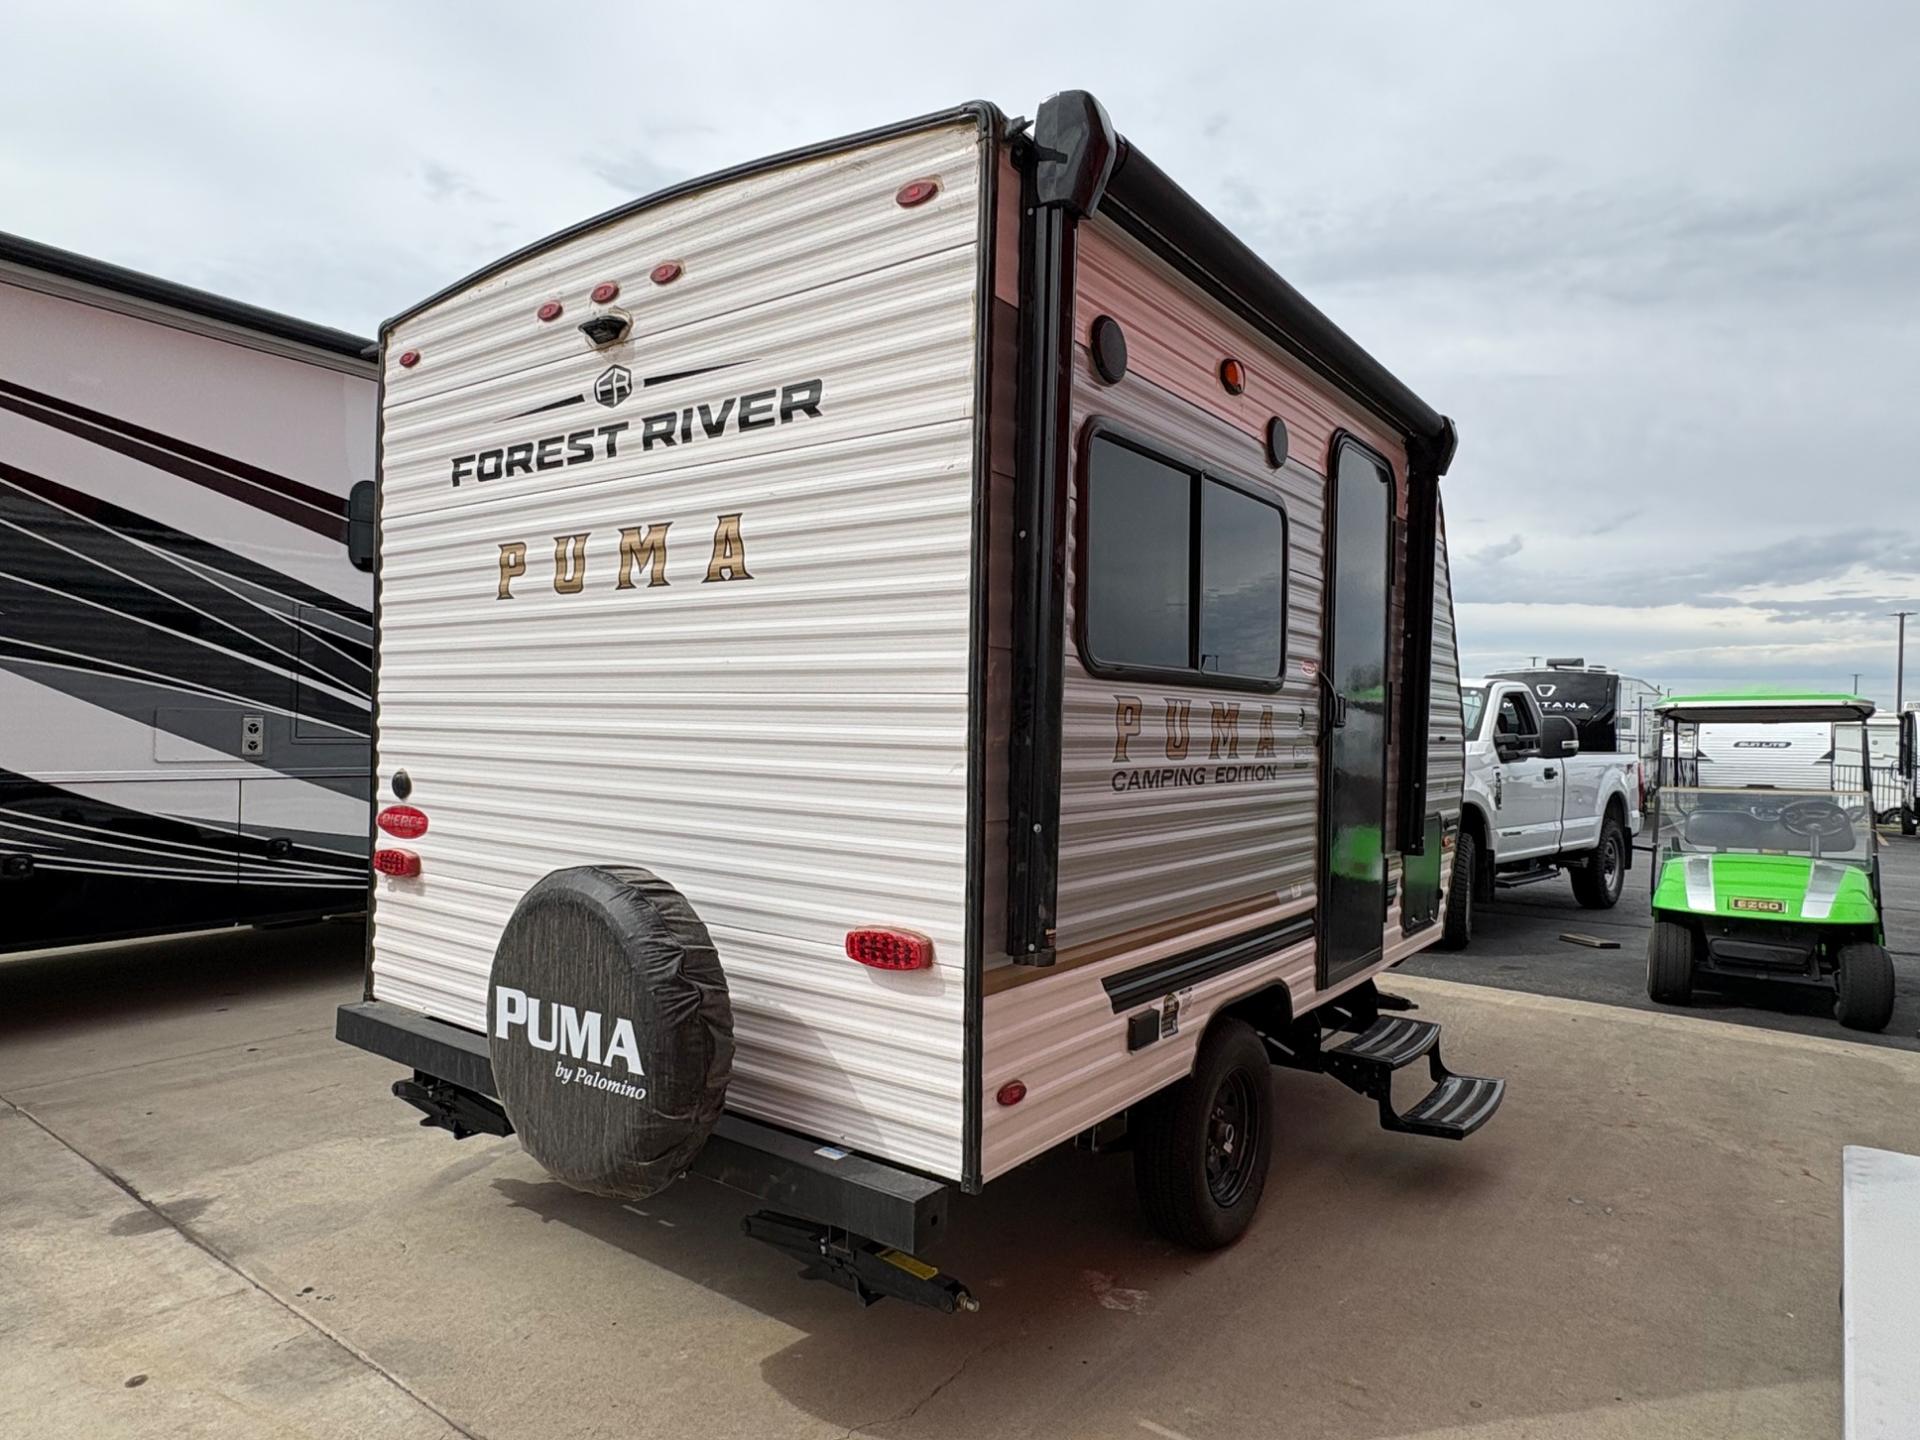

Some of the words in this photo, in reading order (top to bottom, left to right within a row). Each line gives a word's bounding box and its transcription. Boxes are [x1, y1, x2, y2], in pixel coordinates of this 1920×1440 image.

[451, 421, 629, 487] FOREST
[641, 378, 823, 452] RIVER
[496, 513, 755, 600] PUMA
[1112, 695, 1277, 763] PUMA
[1503, 701, 1590, 709] MTANA
[1112, 767, 1206, 791] CAMPING
[1215, 765, 1277, 784] EDITION
[382, 813, 425, 828] PIERCE
[495, 985, 646, 1076] PUMA
[555, 1061, 573, 1084] by
[574, 1067, 647, 1100] Palomino
